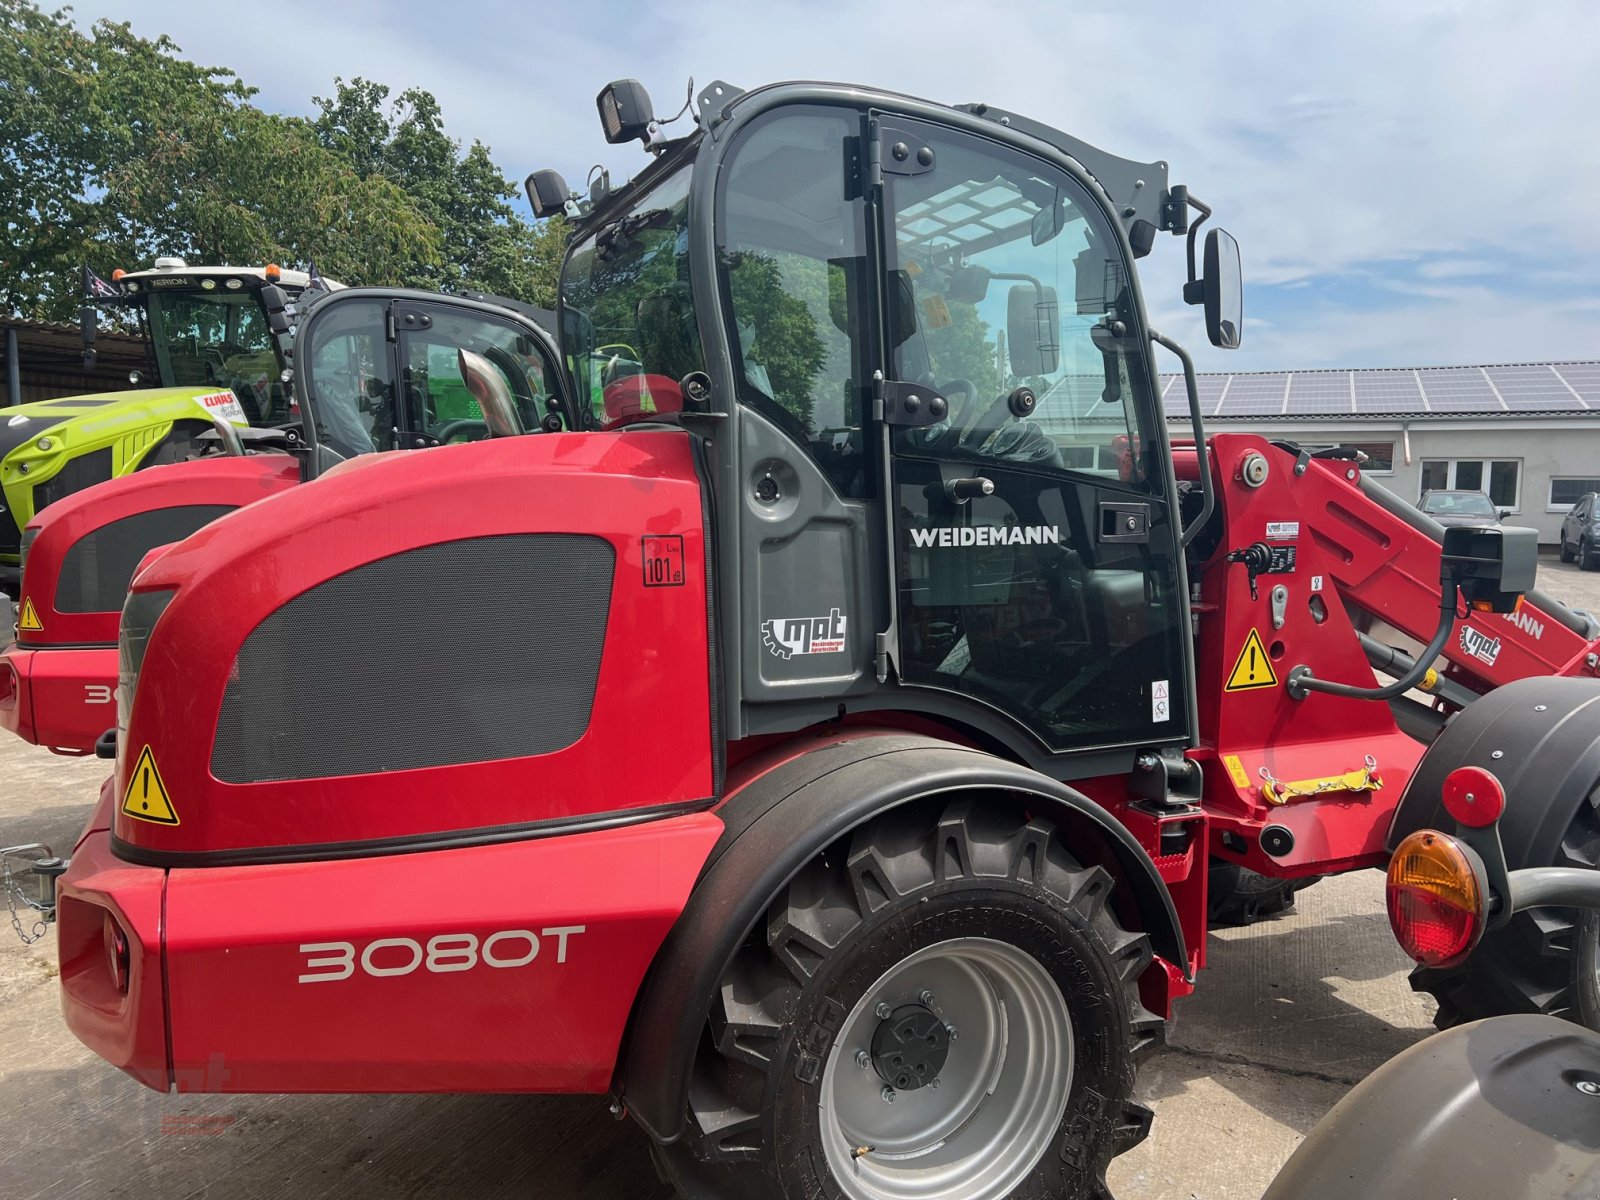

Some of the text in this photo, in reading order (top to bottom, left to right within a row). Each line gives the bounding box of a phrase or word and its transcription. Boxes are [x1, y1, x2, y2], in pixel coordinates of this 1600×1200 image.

[150, 278, 188, 286] XERION
[204, 394, 233, 407] CLAAS
[910, 525, 1059, 548] WEIDEMANN
[647, 557, 670, 583] 101
[783, 608, 845, 653] mat
[84, 685, 119, 704] 3
[298, 925, 586, 984] 3080T
